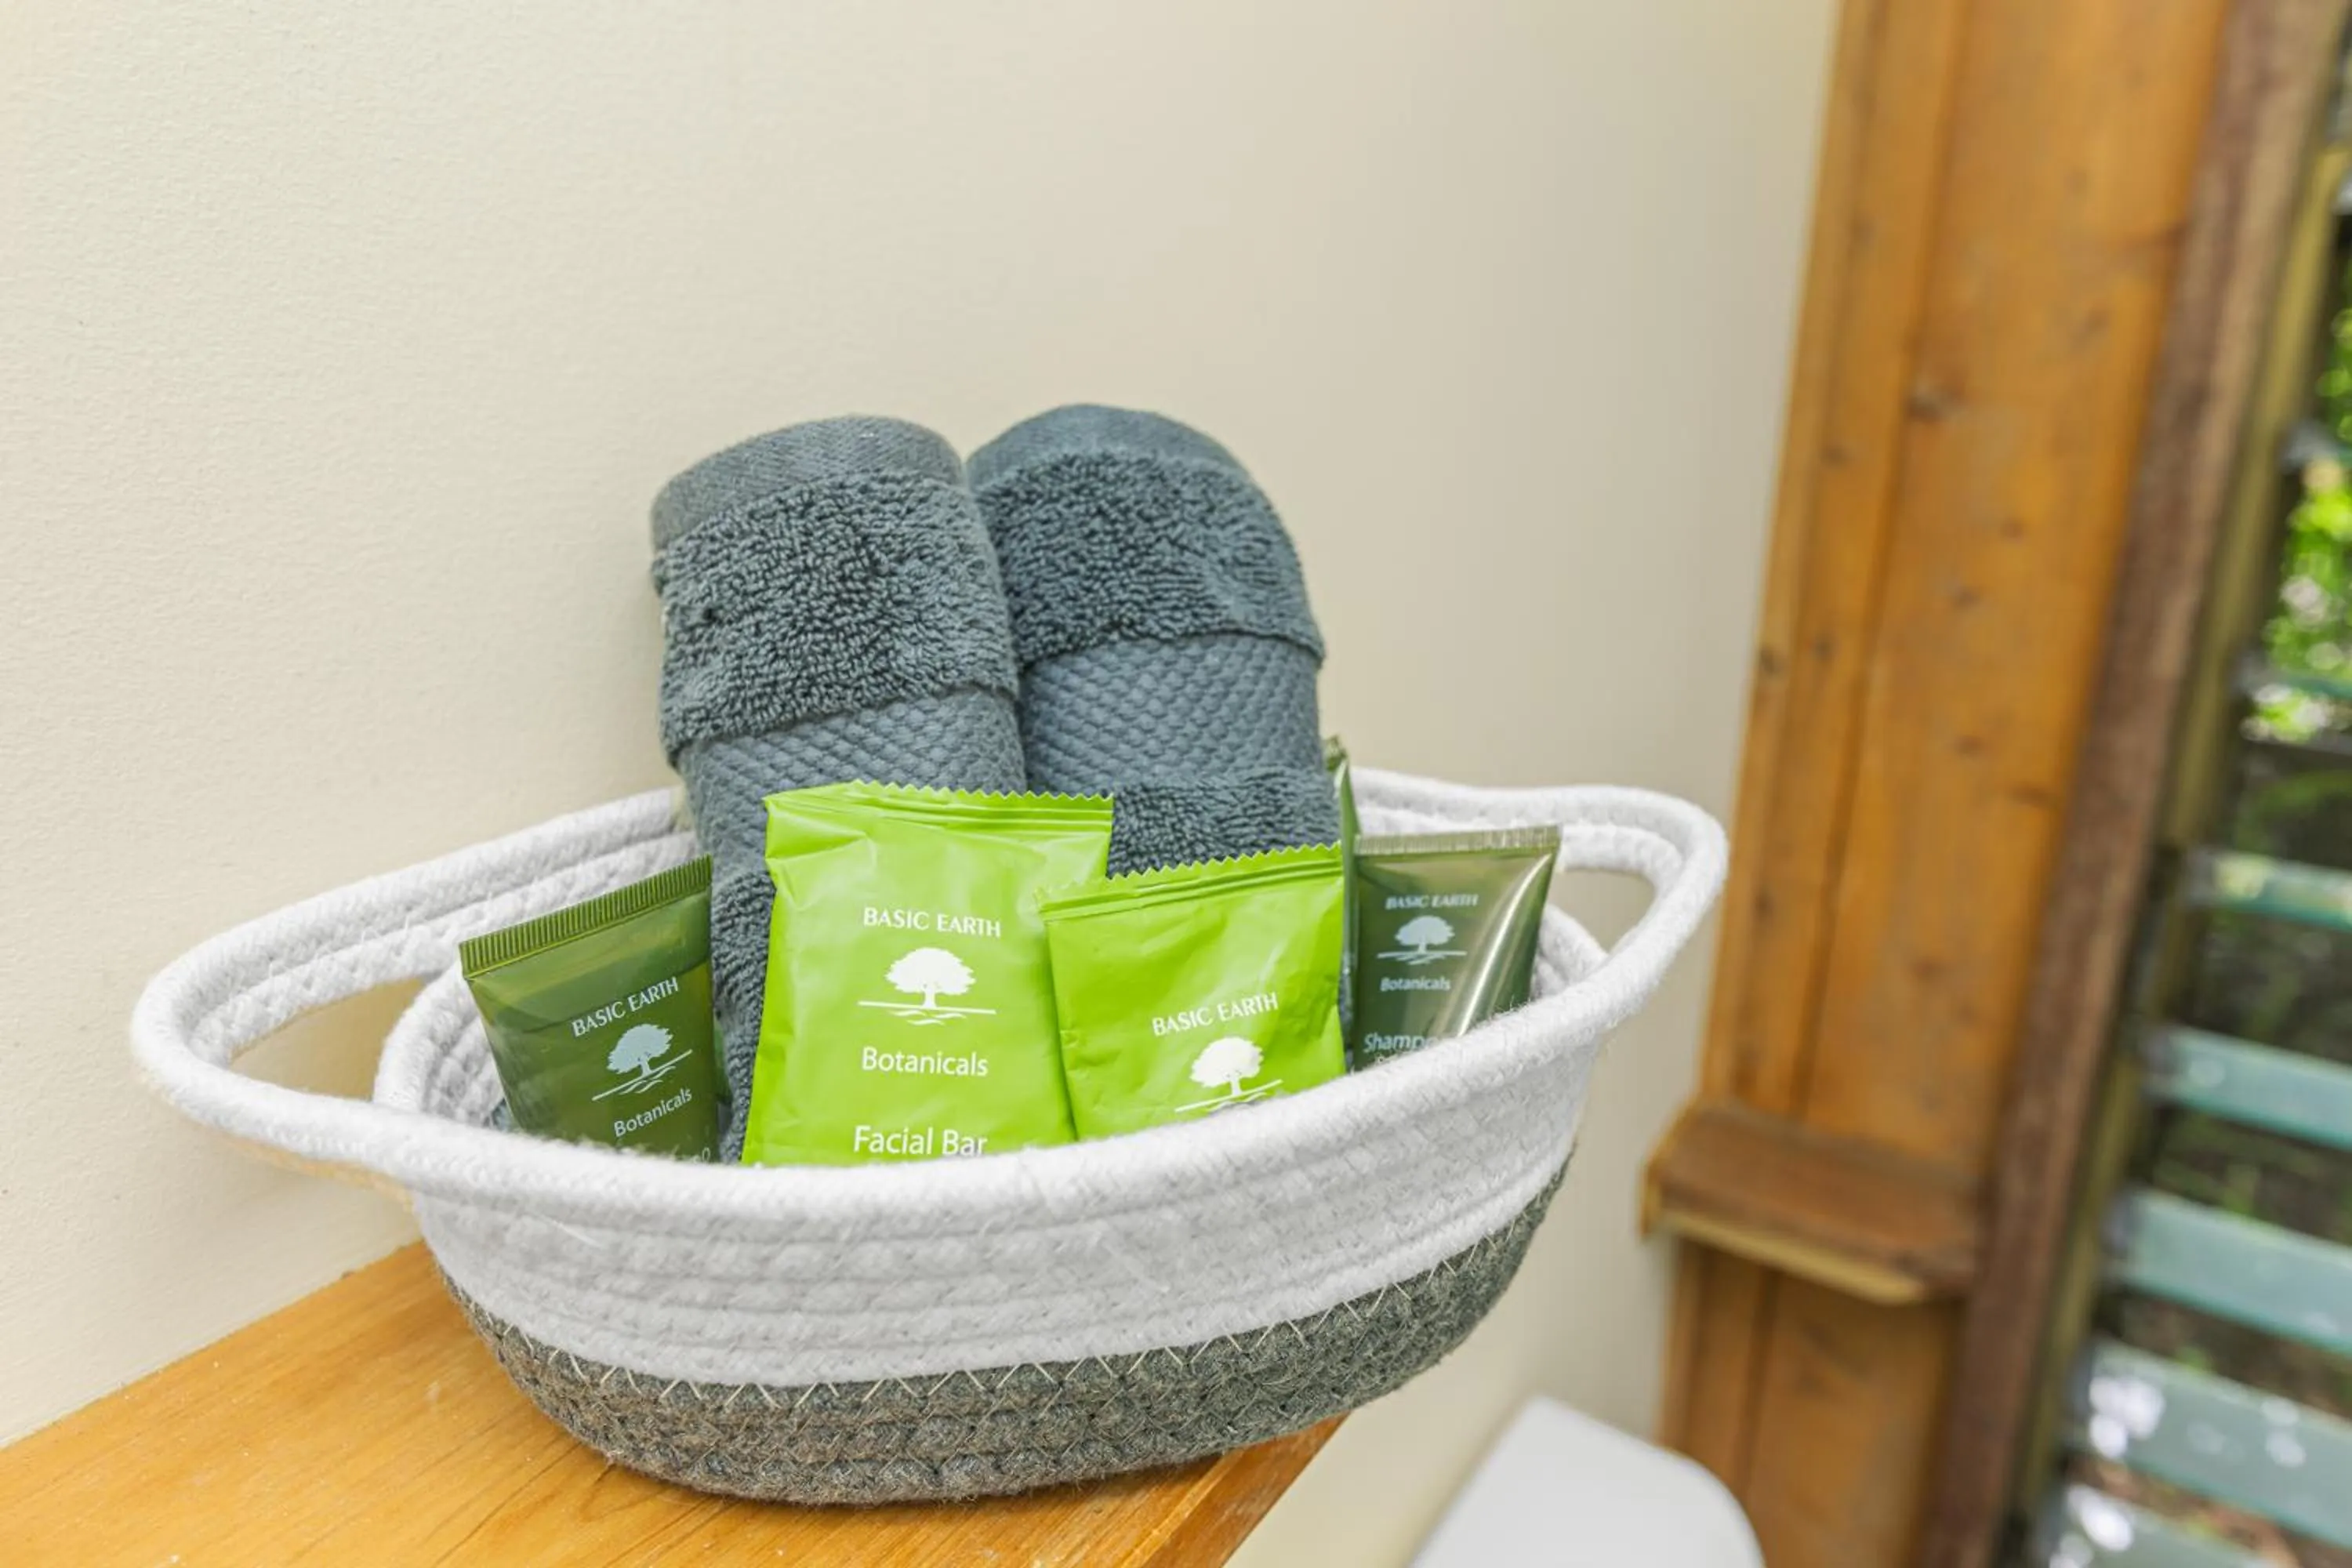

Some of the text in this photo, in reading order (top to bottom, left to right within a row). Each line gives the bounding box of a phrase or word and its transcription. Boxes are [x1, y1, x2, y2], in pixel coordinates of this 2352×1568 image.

[1385, 895, 1478, 909] BASIC EARTH
[864, 907, 1000, 938] BASIC EARTH
[1380, 977, 1450, 992] Botanicals
[572, 977, 679, 1037] BASIC EARTH
[1152, 993, 1278, 1036] BASIC EARTH
[862, 1047, 988, 1076] Botanicals
[614, 1088, 692, 1137] Botanicals
[853, 1125, 988, 1156] Facial Bar
